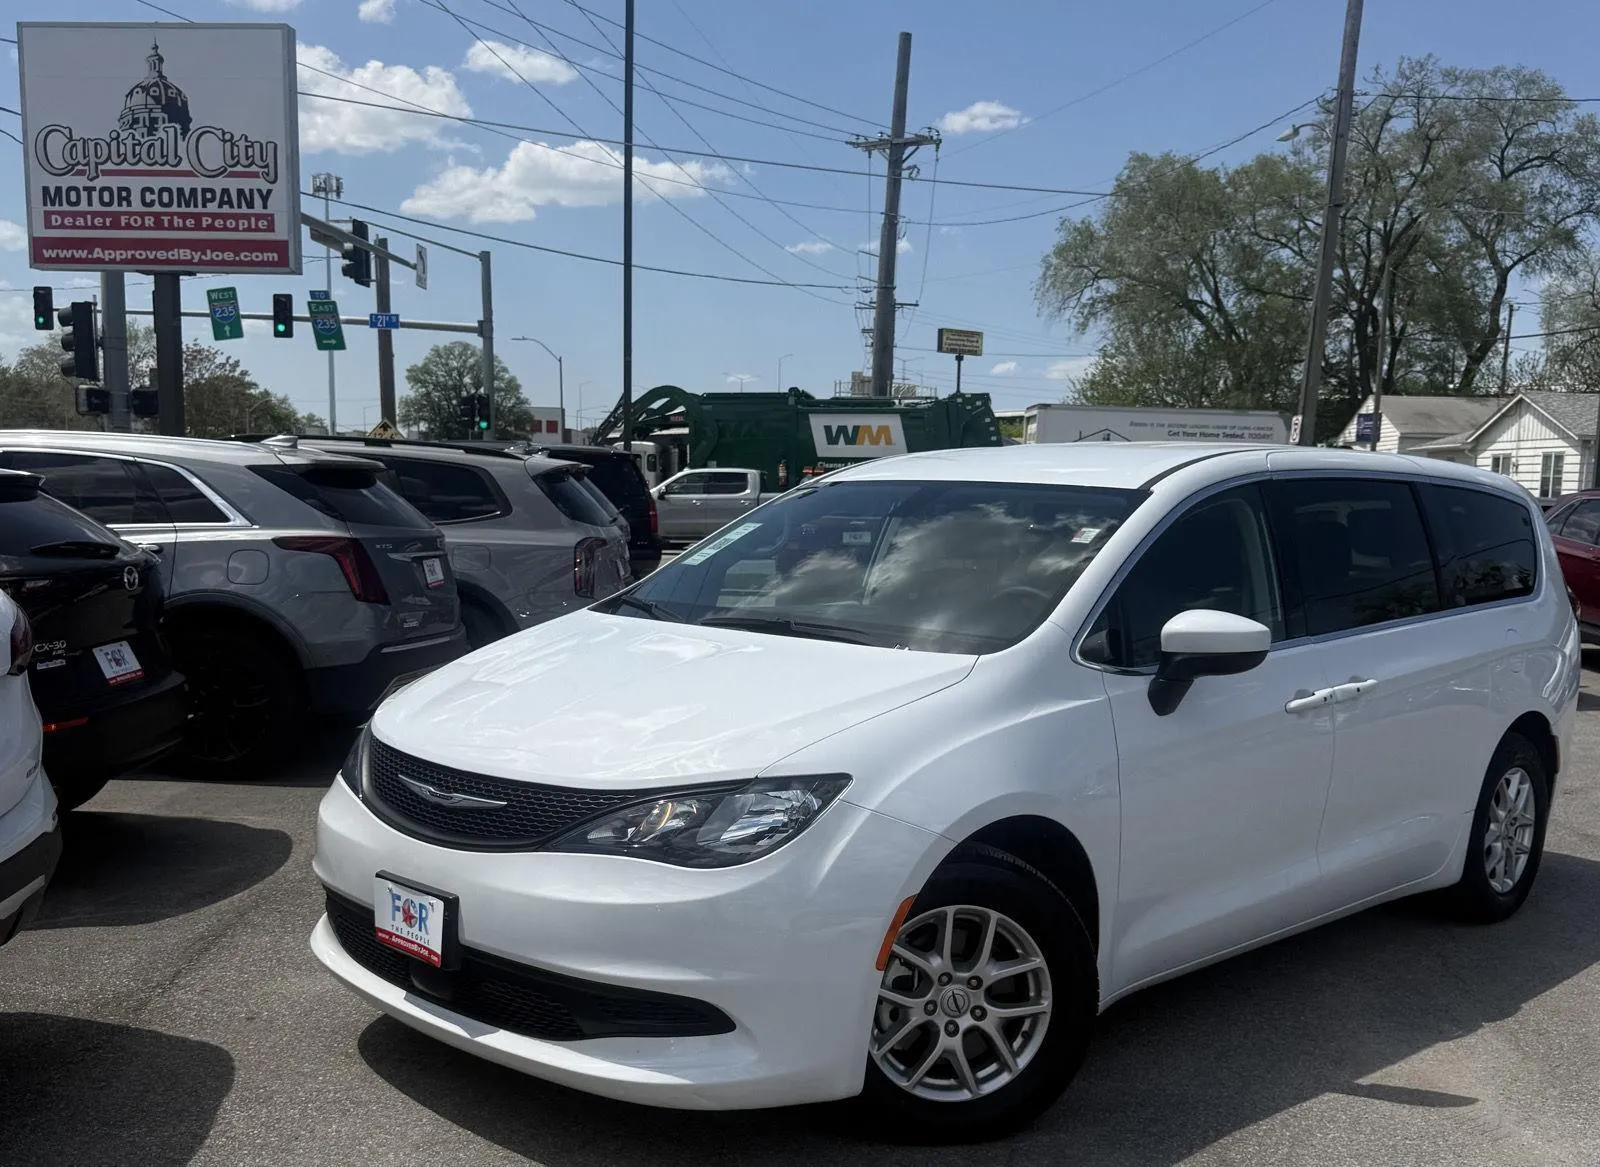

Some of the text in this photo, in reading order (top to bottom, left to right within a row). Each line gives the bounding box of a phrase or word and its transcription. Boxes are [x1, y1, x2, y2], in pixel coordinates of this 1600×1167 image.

[34, 124, 278, 184] Capital City
[41, 185, 273, 210] MOTOR COMPANY
[51, 214, 269, 230] Dealer FOR The People
[42, 246, 279, 263] www.ApprovedByJoe.com
[209, 291, 233, 300] WEST
[215, 306, 236, 318] 235
[311, 303, 334, 312] EAST
[316, 319, 337, 329] 235
[823, 425, 893, 446] WM
[1199, 431, 1220, 439] Home
[34, 640, 67, 653] CX-30
[391, 893, 430, 936] FOR
[391, 924, 431, 947] THE PEOPLE
